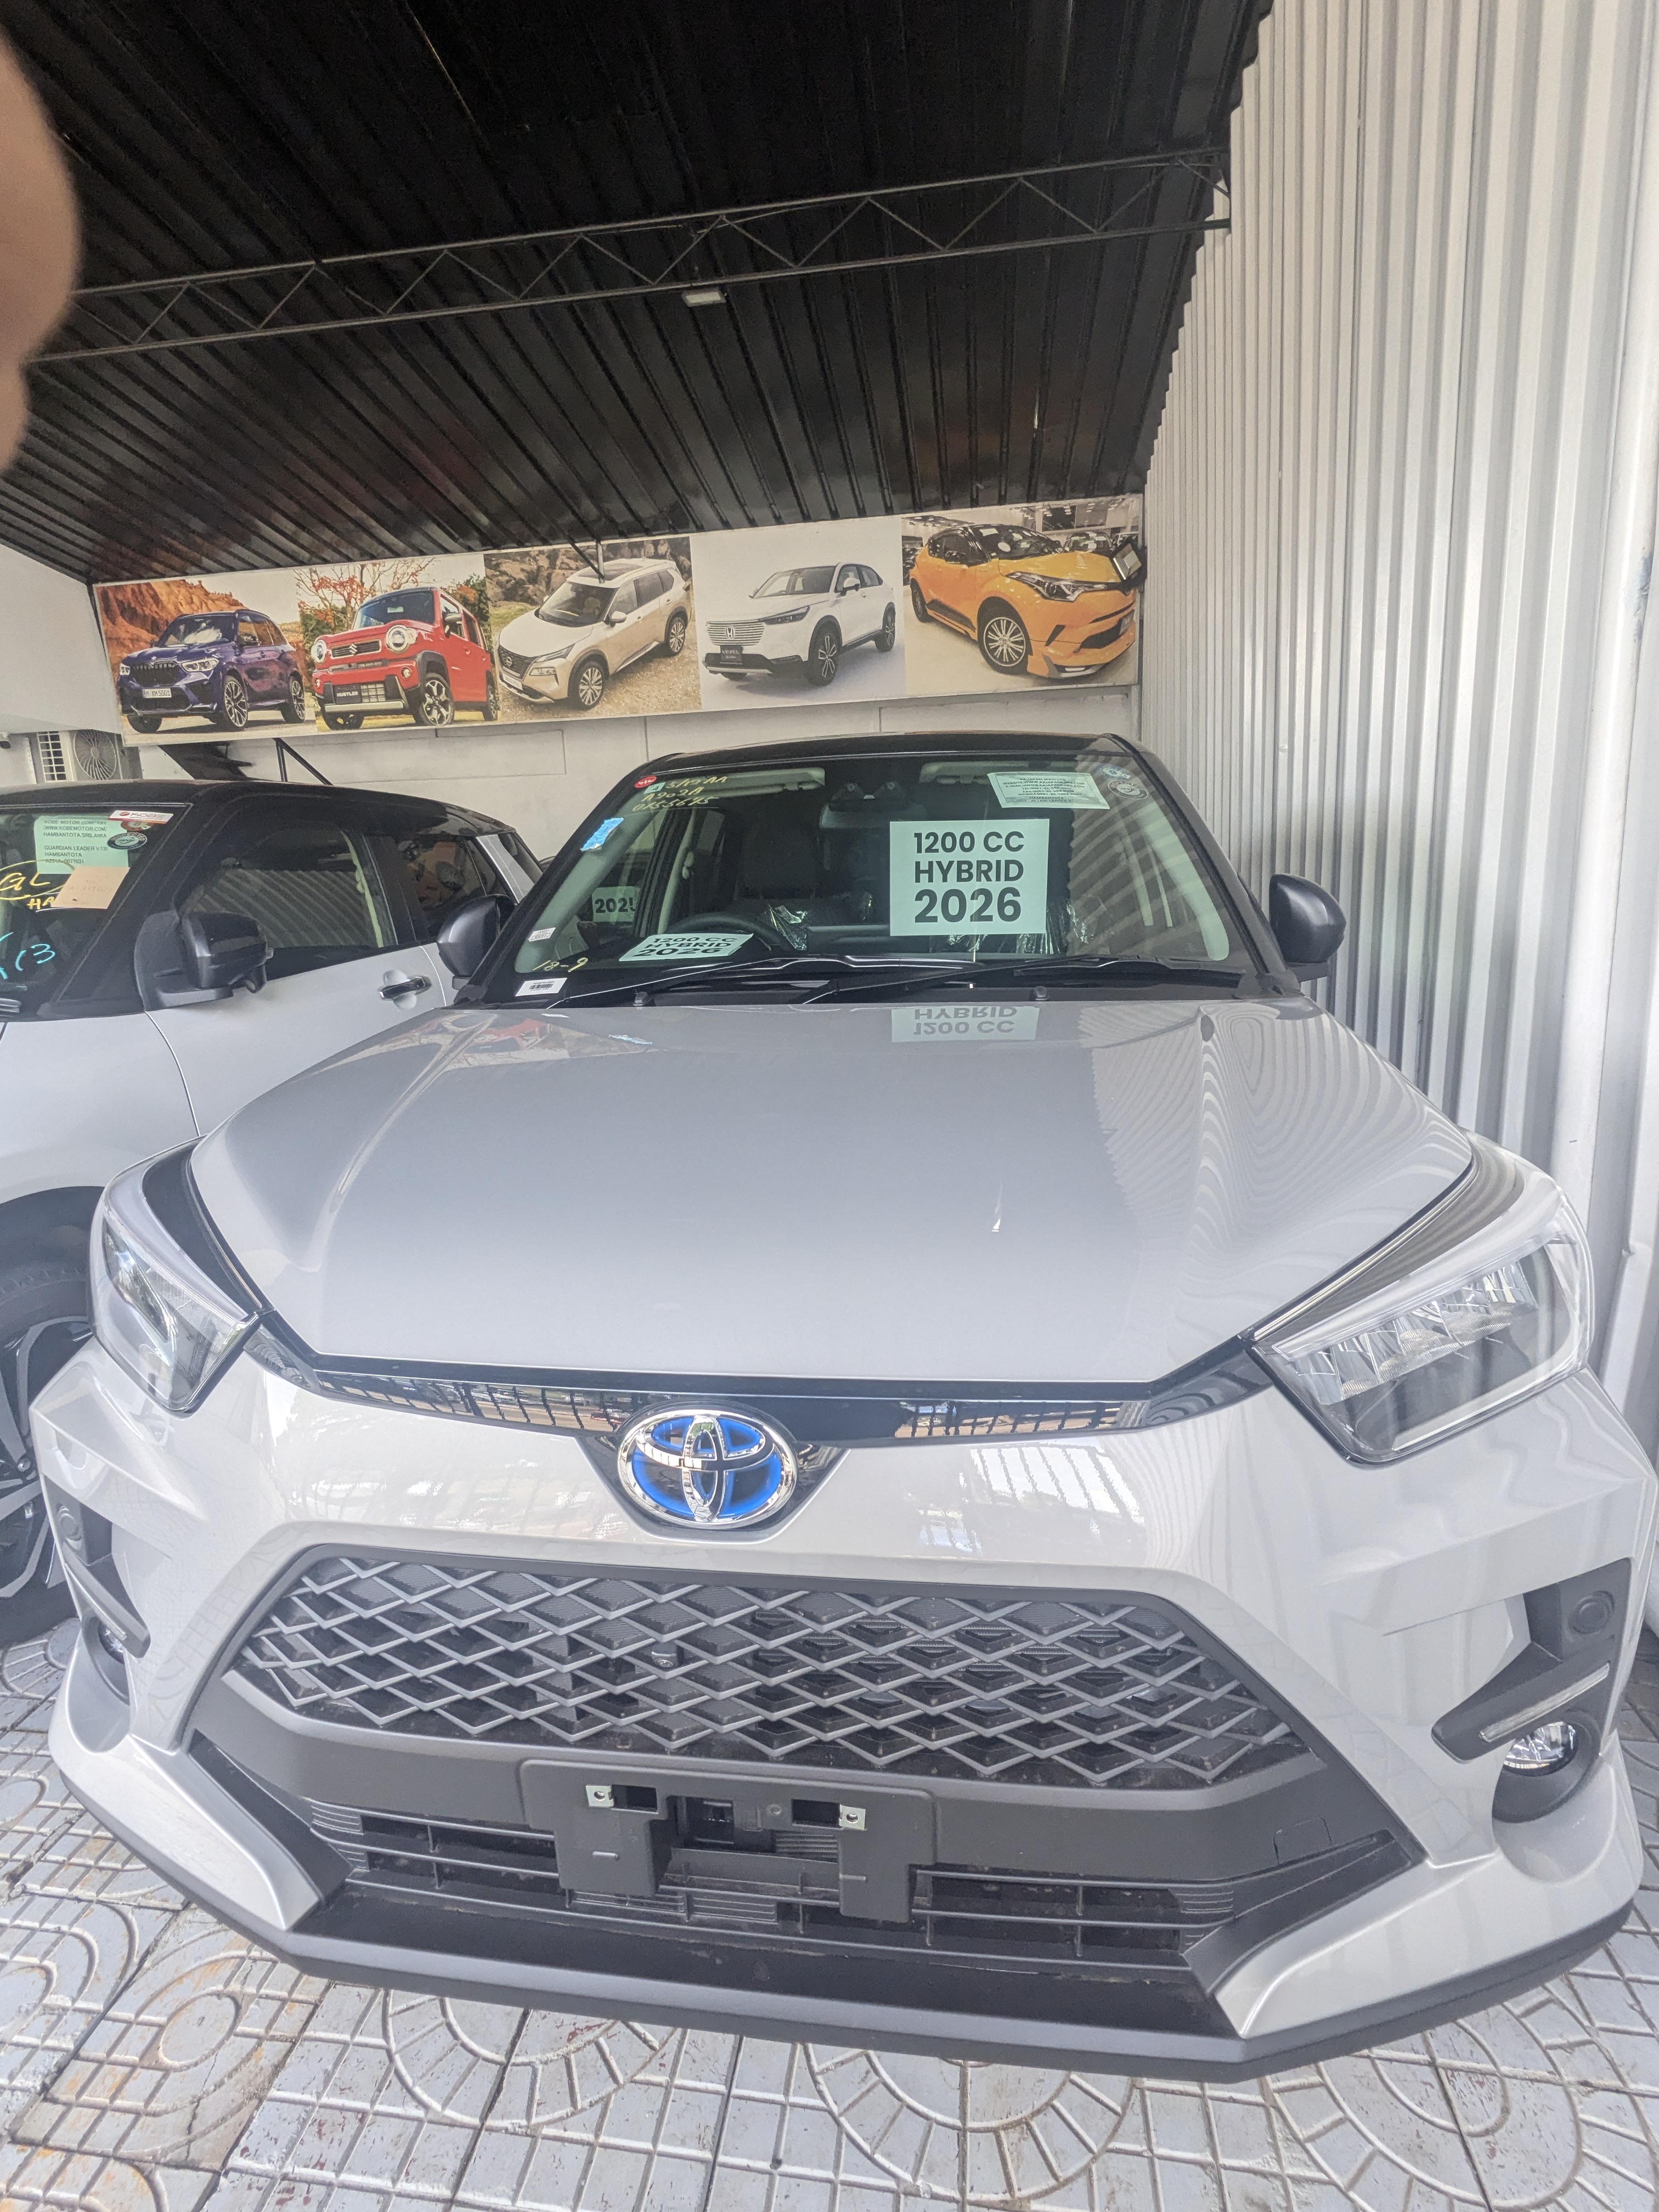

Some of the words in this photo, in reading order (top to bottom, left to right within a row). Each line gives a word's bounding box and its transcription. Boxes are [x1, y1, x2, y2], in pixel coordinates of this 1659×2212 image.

[914, 831, 975, 854] 1200
[983, 831, 1024, 852] CC
[915, 860, 1024, 883] HYBRID
[915, 887, 1021, 923] 2026
[633, 947, 723, 957] 2026
